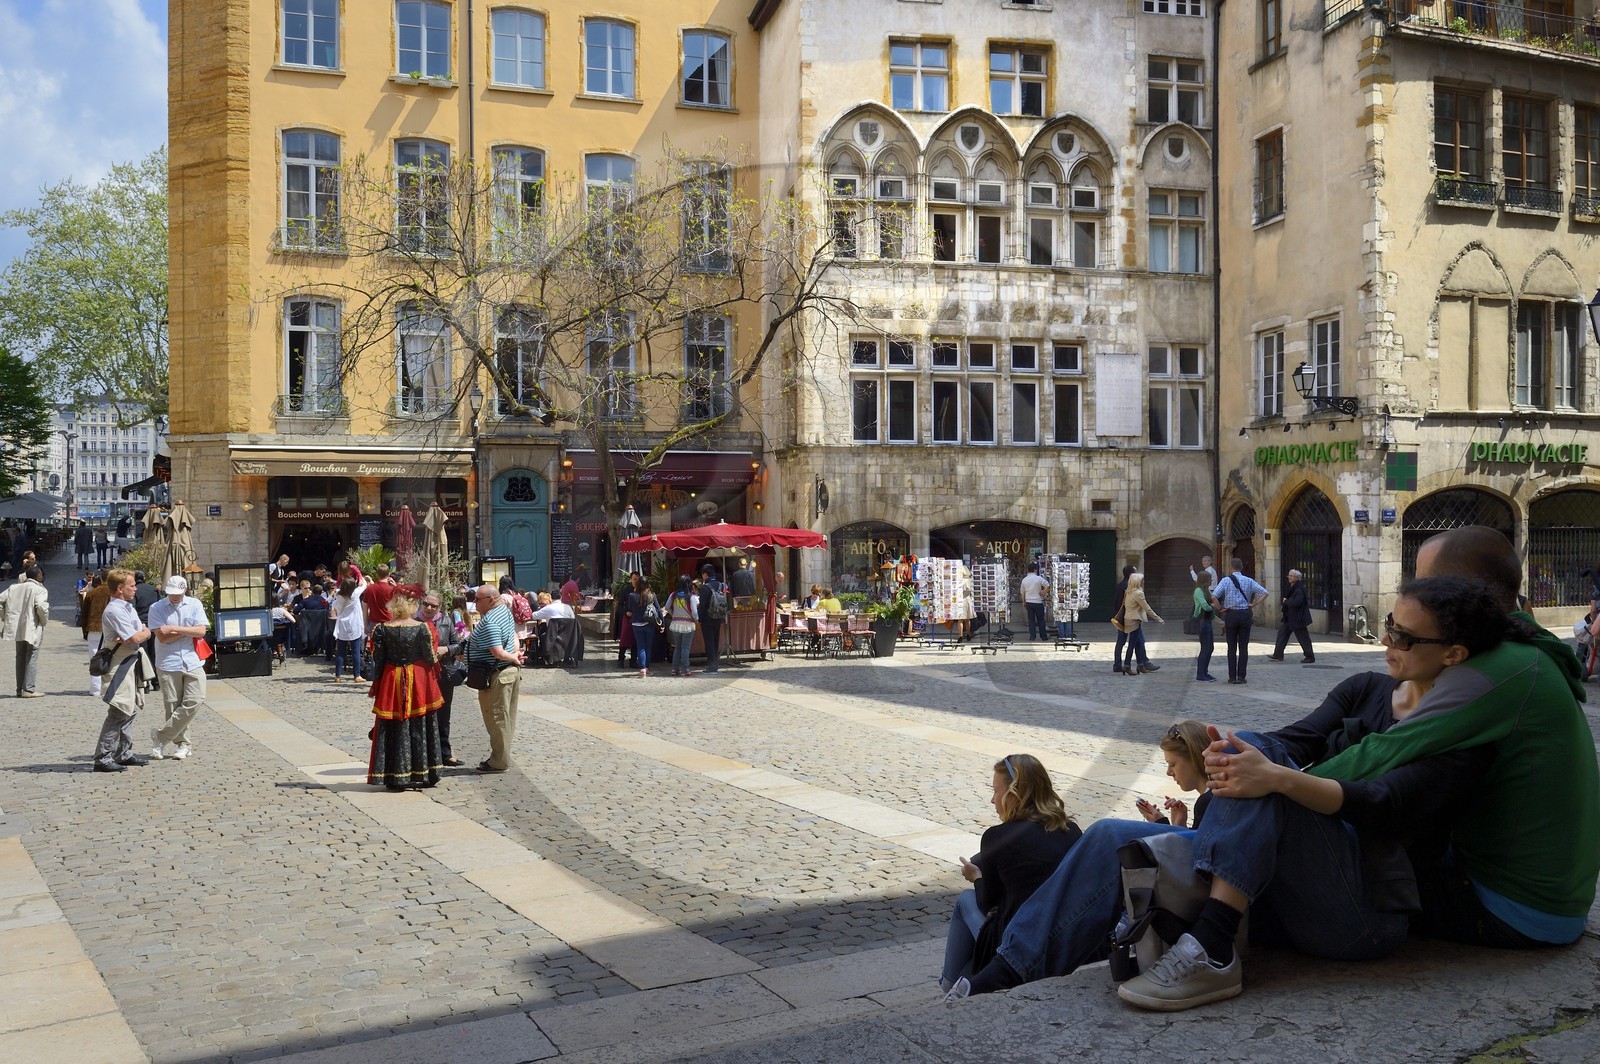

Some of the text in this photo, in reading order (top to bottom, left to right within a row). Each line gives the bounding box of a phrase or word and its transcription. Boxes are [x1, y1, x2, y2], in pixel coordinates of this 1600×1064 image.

[1256, 440, 1359, 466] PHARMACIE
[1473, 441, 1588, 464] PHARMACIE
[300, 463, 406, 475] Bouchon Lyonnais
[278, 511, 350, 520] Bouchon Lyonnais
